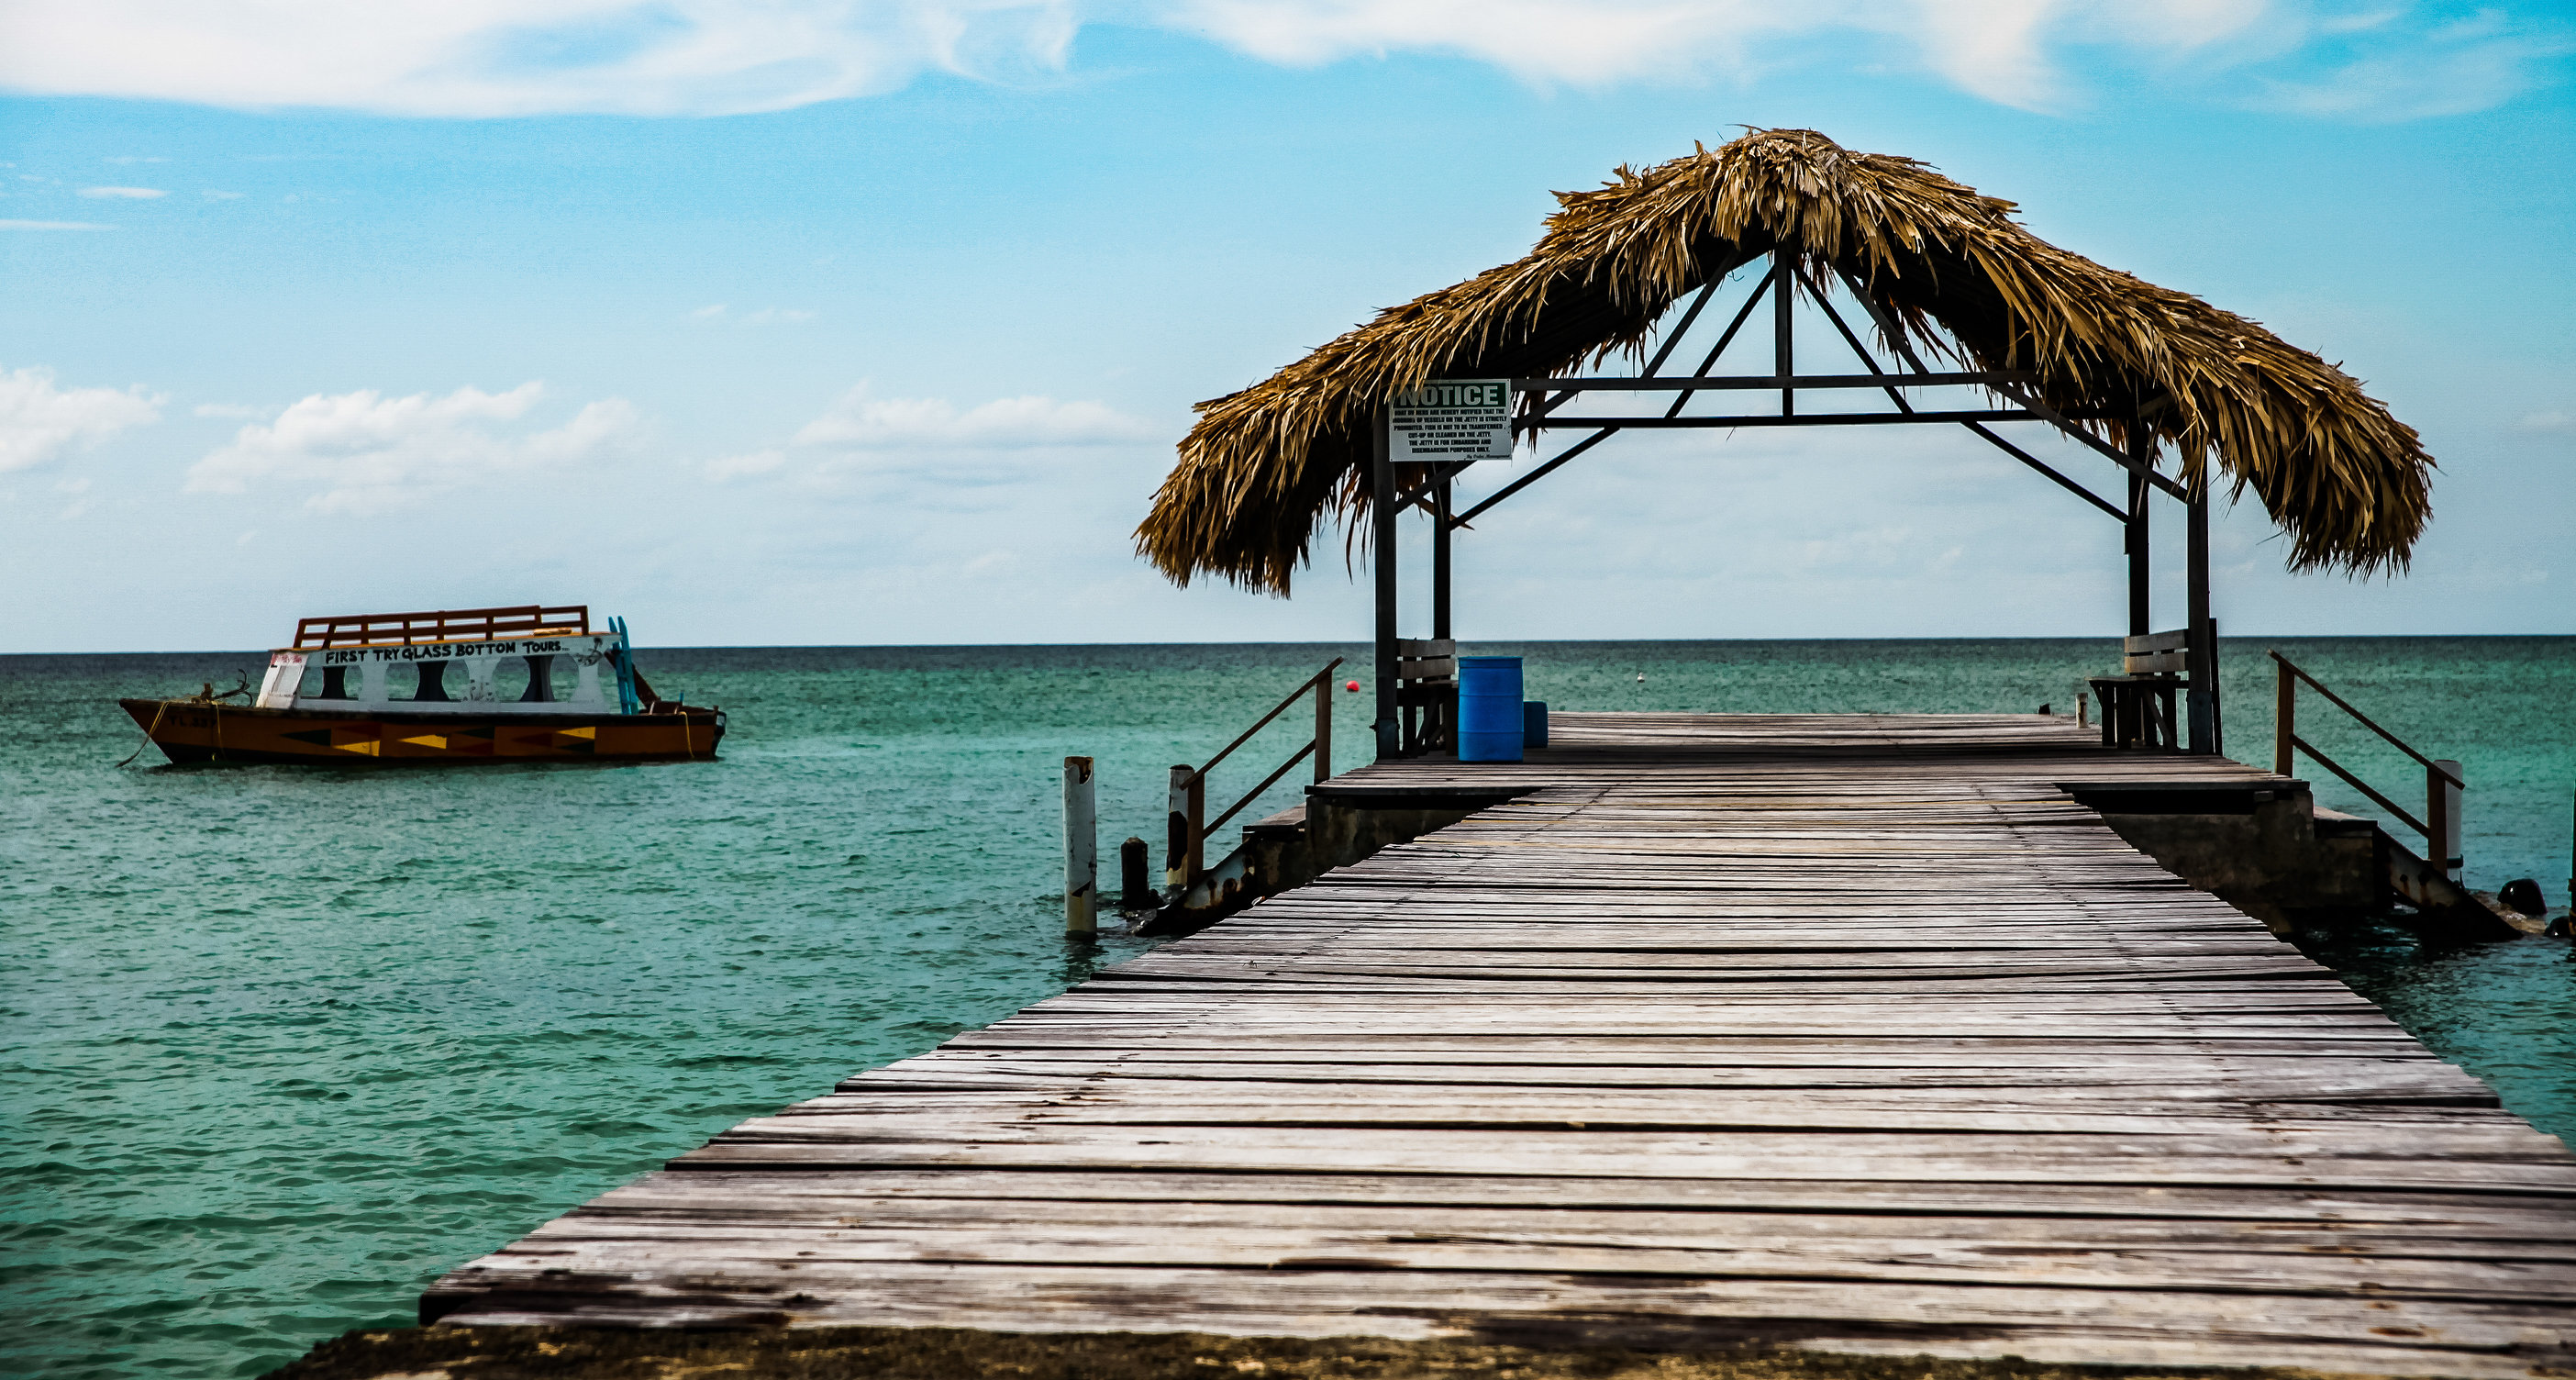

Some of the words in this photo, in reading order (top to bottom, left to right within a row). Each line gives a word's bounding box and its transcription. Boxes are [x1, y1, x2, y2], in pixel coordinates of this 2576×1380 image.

[1400, 385, 1498, 406] NOTICE
[326, 651, 368, 664] FIRST
[372, 649, 400, 662] TRY
[402, 645, 451, 661] GLASS
[455, 642, 516, 656] BOTTOM
